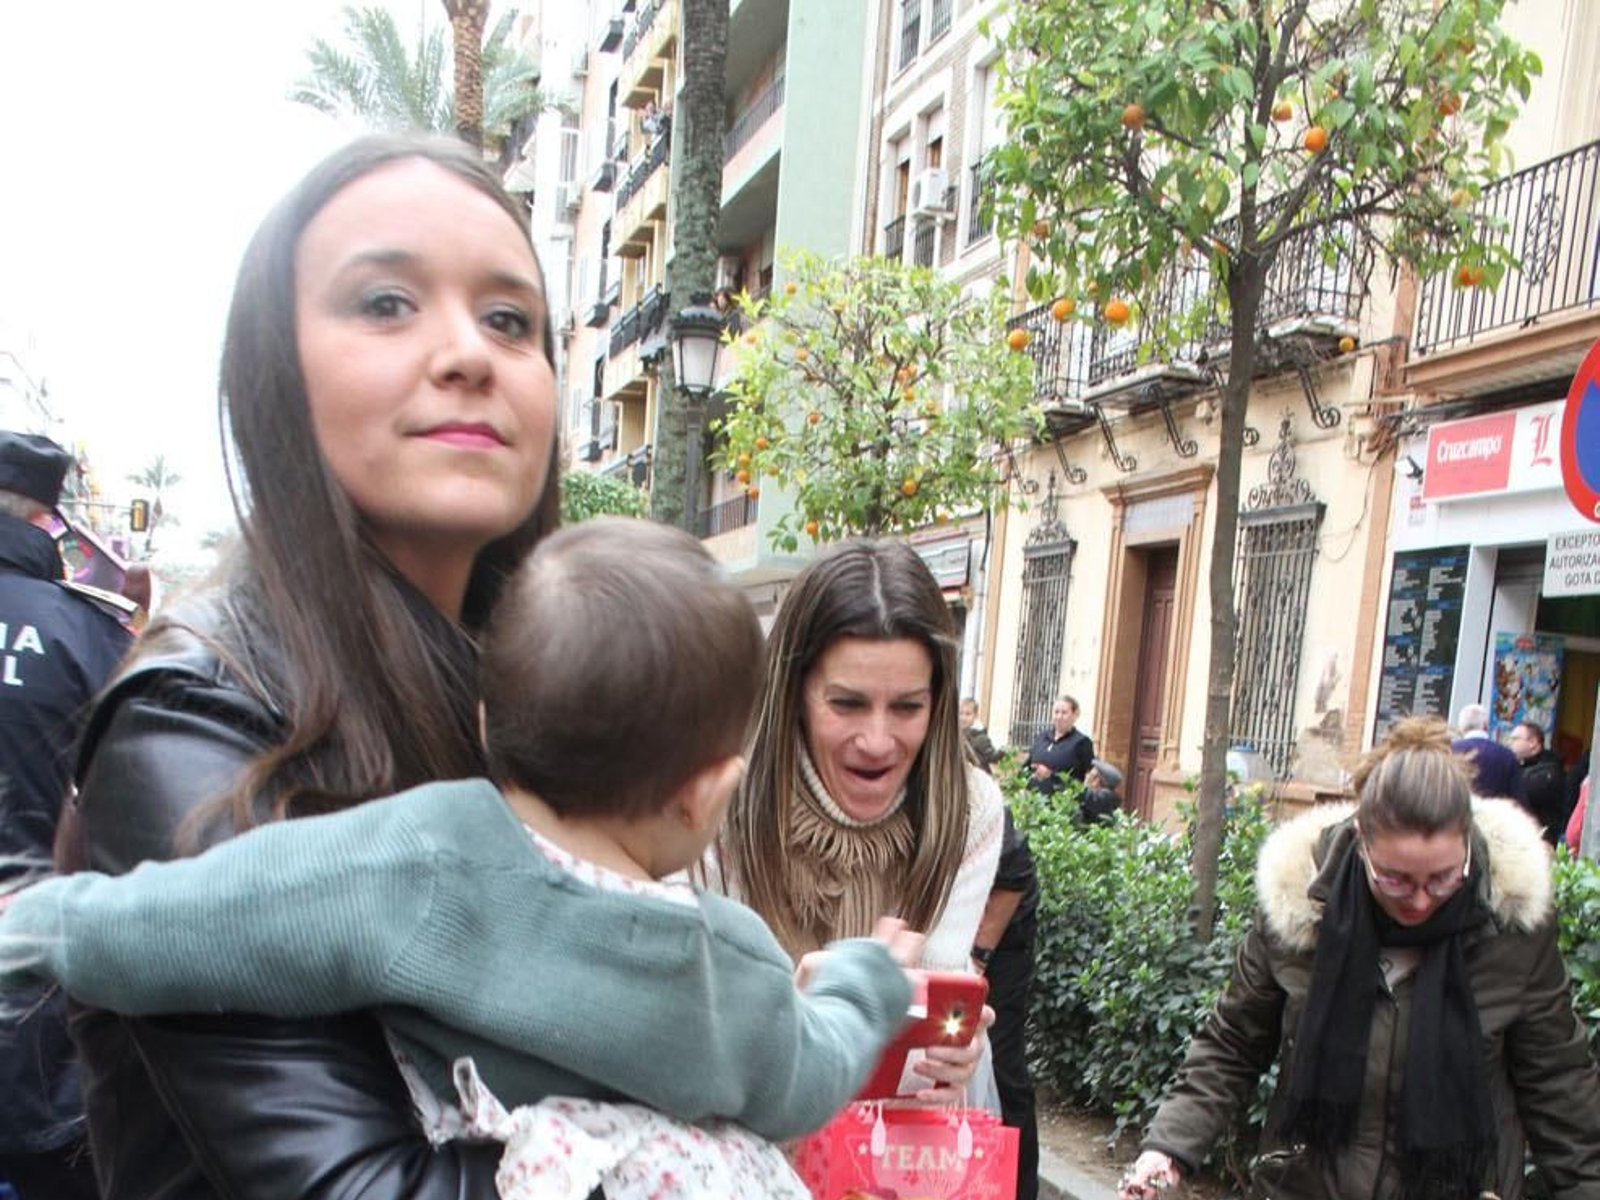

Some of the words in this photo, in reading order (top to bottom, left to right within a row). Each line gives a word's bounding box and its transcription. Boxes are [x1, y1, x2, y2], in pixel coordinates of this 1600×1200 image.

[1437, 435, 1503, 463] Cruzcampo
[1549, 553, 1600, 570] AUTORIZA
[1565, 572, 1591, 587] GOTA
[881, 1144, 963, 1171] TEAM
